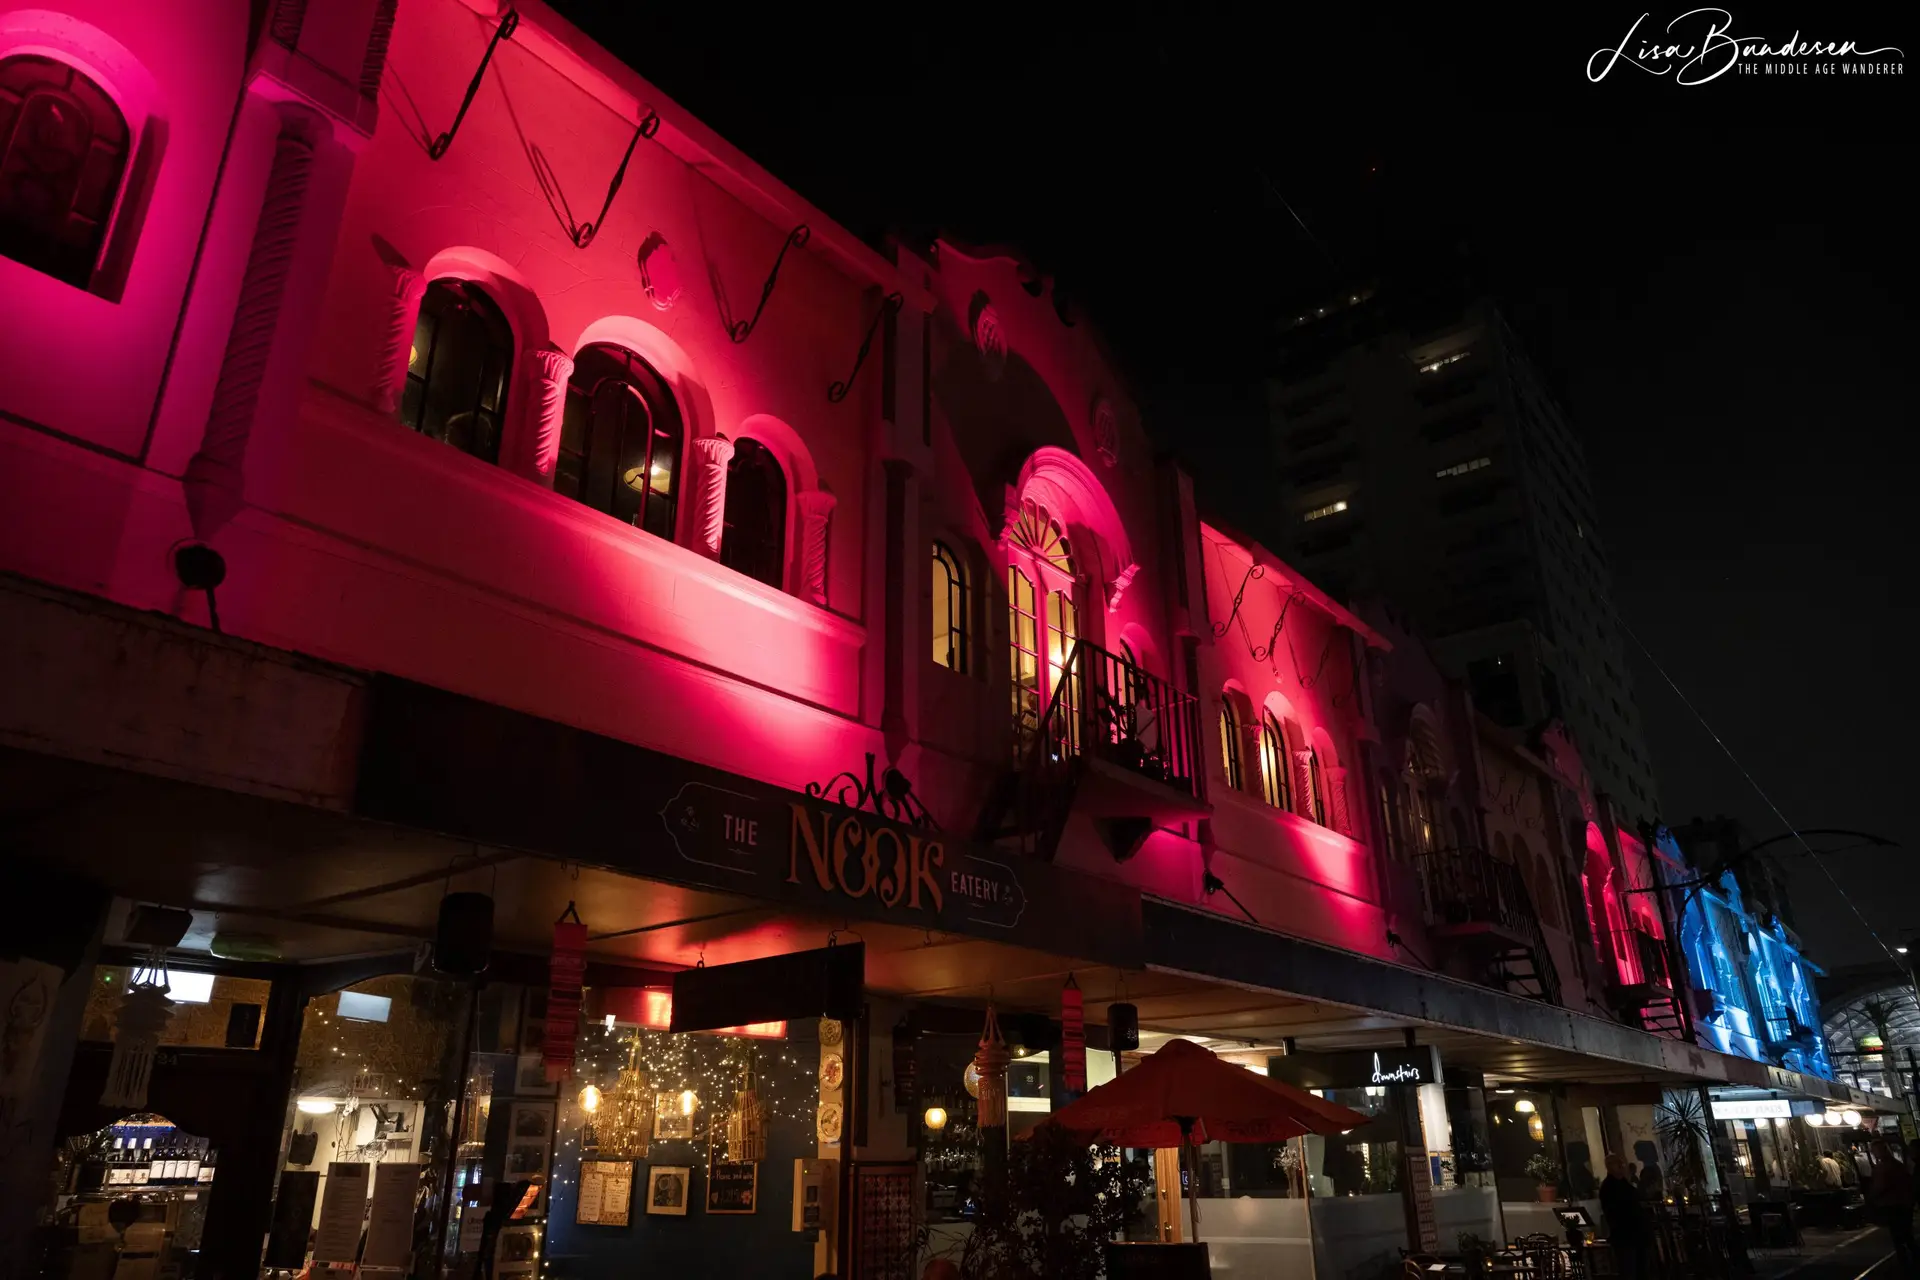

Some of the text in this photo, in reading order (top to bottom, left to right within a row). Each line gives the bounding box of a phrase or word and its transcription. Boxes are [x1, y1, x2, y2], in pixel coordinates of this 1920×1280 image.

[722, 803, 999, 914] THE NOOK EATERY
[1371, 1051, 1420, 1083] downstairs
